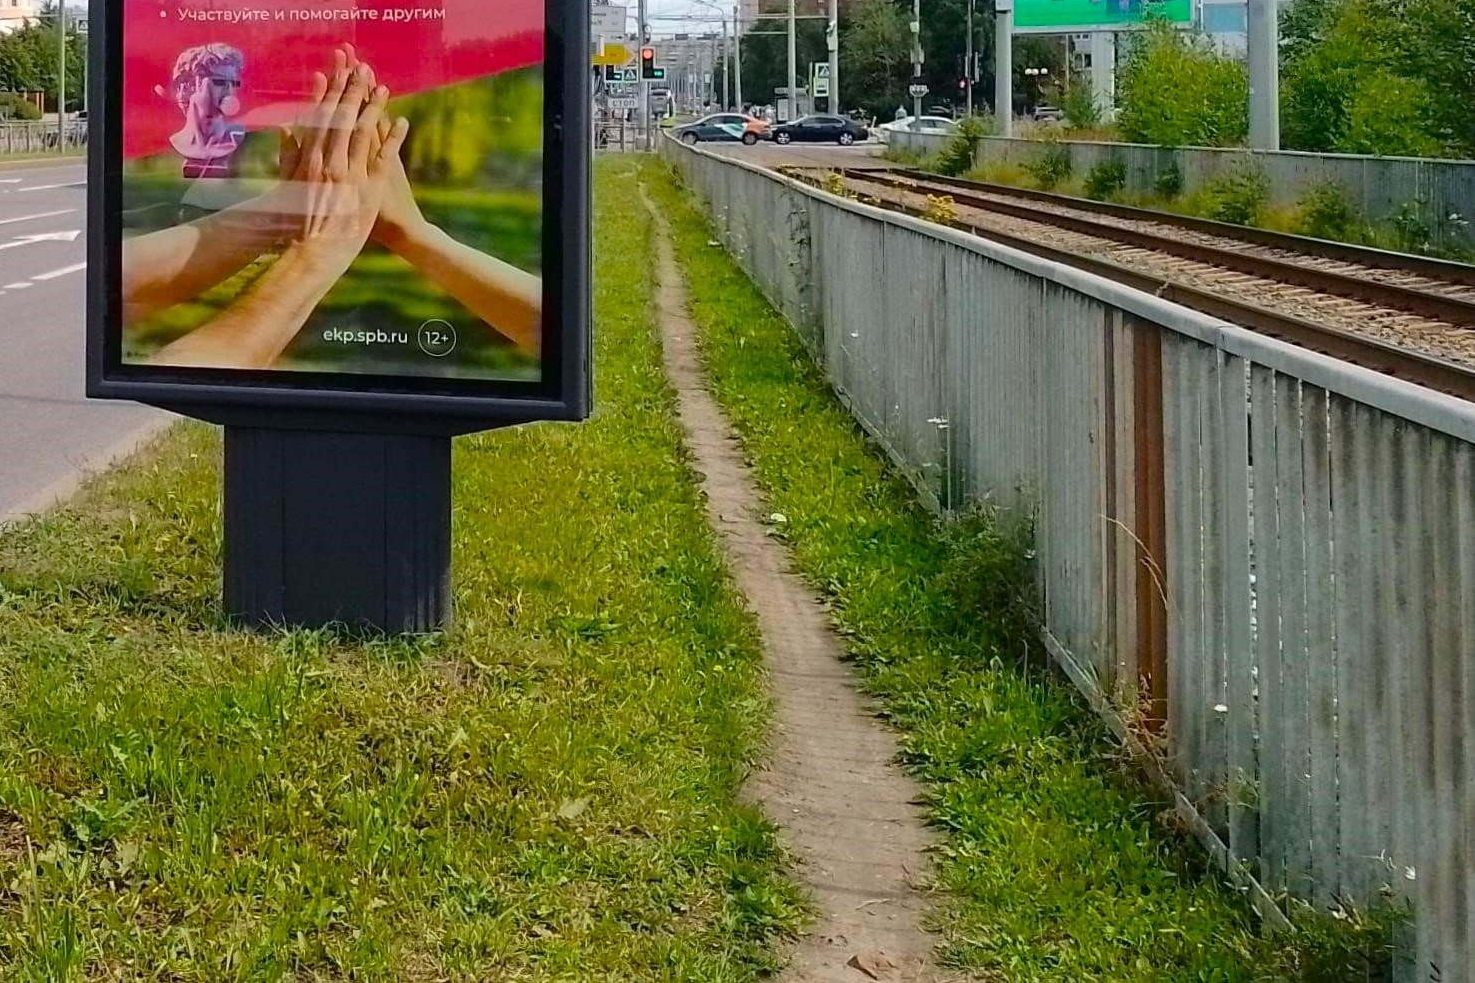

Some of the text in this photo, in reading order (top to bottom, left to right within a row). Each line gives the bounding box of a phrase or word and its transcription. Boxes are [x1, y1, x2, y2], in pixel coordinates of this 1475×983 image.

[178, 6, 446, 23] Участвуйте и помогайте другим
[323, 328, 448, 345] ekp.spb.ru 12+
